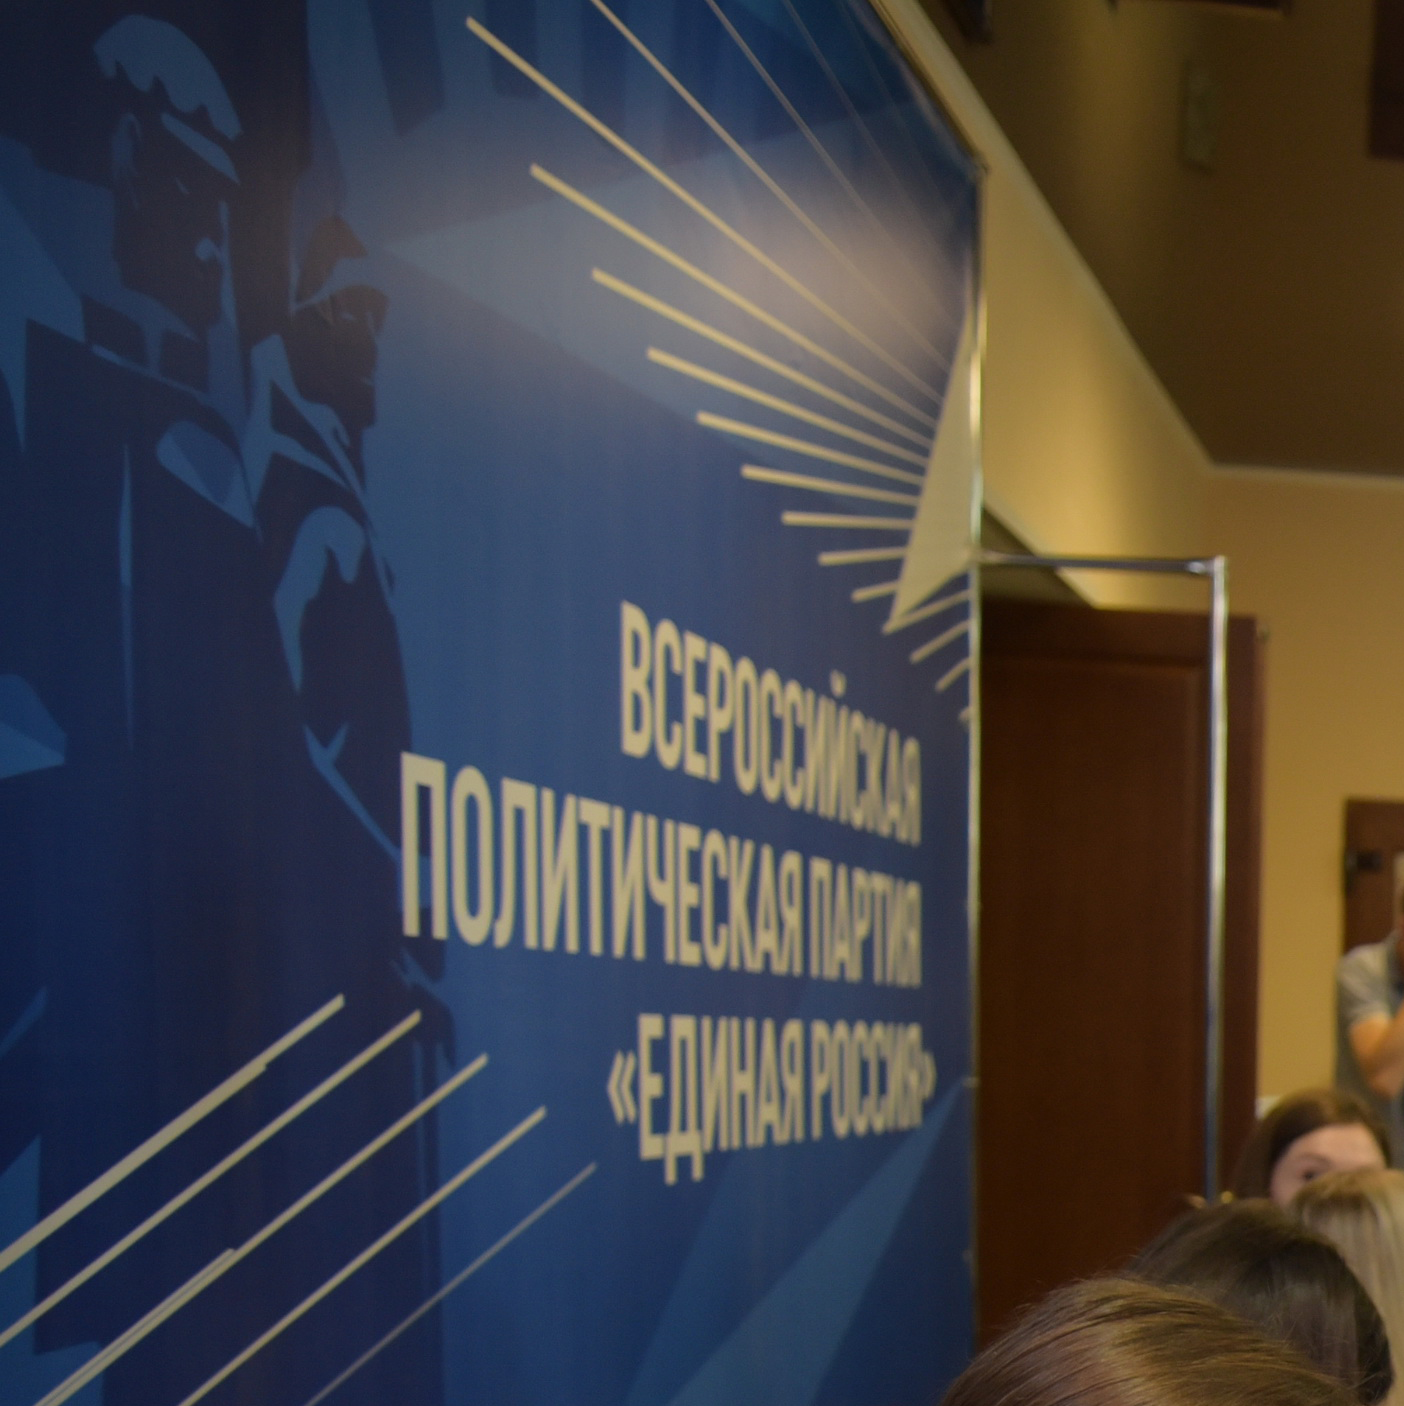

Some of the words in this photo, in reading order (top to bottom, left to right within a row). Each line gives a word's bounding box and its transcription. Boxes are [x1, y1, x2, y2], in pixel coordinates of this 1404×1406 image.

[620, 600, 921, 846] ВСЕРОССИЙСКАЯ
[401, 751, 803, 977] ПОЛИТИЧЕСКАЯ
[810, 855, 922, 988] ПАРТИЯ
[607, 1012, 803, 1186] «ЕДИНАЯ
[811, 1020, 937, 1141] РОССИЯ»
